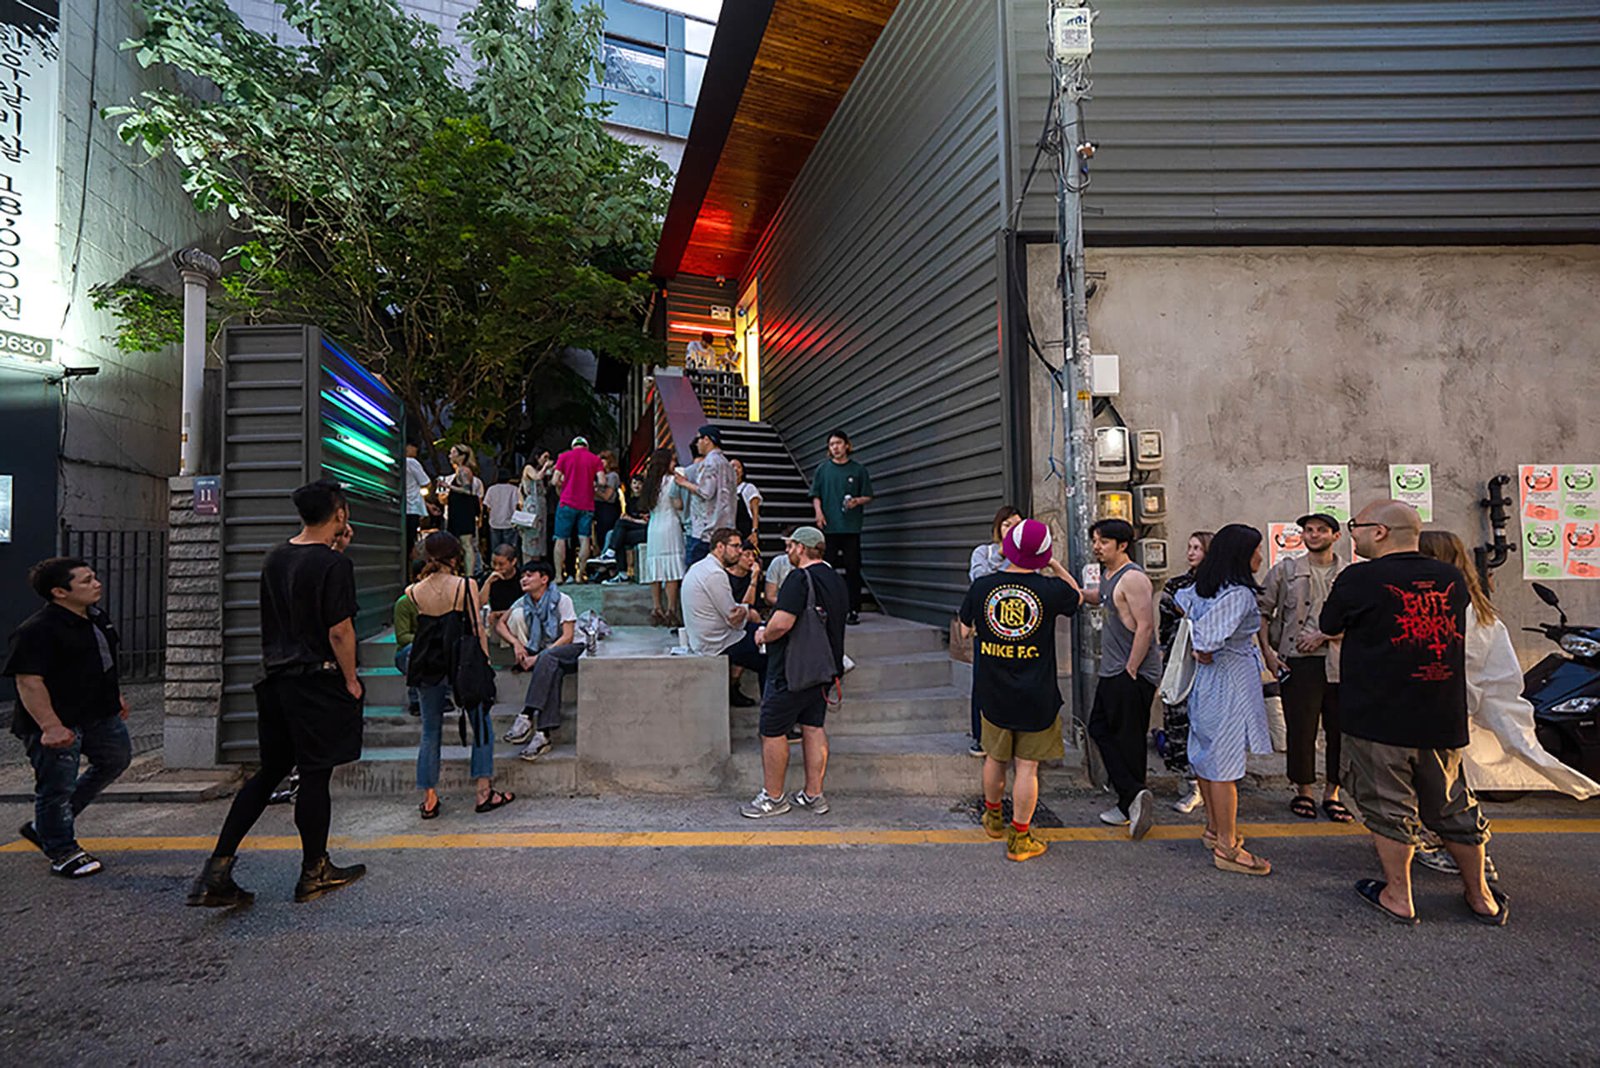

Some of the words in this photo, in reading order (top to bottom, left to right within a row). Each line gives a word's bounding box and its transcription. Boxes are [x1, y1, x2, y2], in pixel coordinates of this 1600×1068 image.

[201, 489, 211, 501] 11
[981, 641, 1014, 658] NIKE
[1017, 646, 1040, 659] F.C.
